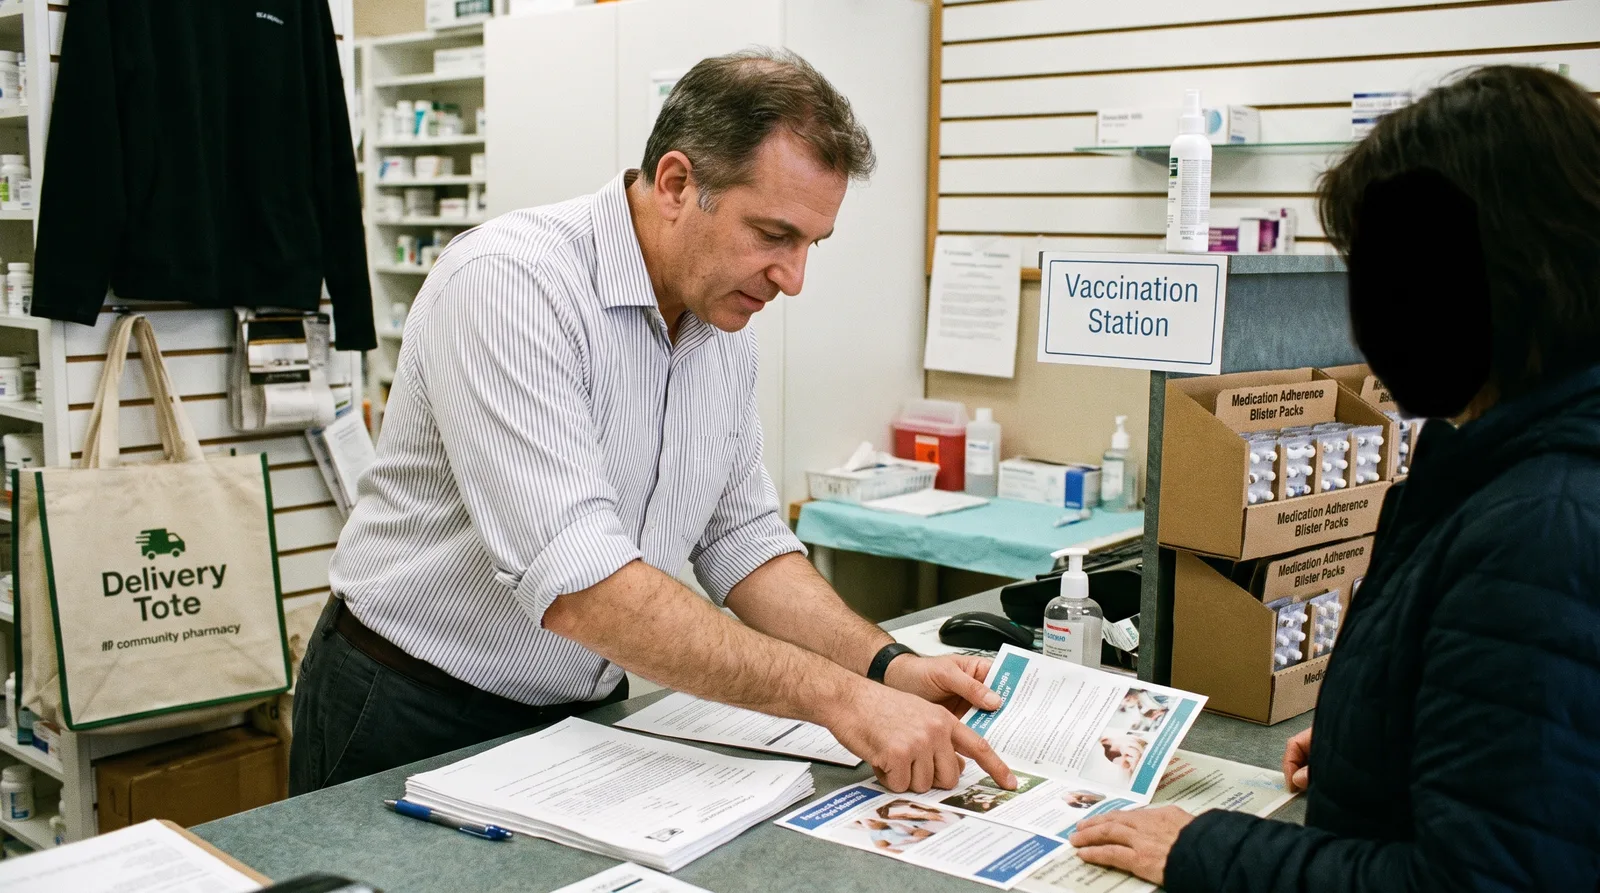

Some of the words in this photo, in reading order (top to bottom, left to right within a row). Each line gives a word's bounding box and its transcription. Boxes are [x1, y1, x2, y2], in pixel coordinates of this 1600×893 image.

[1065, 273, 1198, 303] Vaccination
[1088, 308, 1169, 337] Station
[1231, 392, 1278, 407] Medication
[1280, 388, 1324, 402] Adherence
[1249, 408, 1277, 421] Blister
[1279, 405, 1304, 418] Packs
[1277, 507, 1323, 525] Medication
[1326, 499, 1369, 515] Adherence
[1295, 522, 1322, 537] Blister
[1324, 516, 1349, 531] Packs
[1278, 557, 1322, 578] Medication
[1324, 546, 1365, 565] Adherence
[1322, 565, 1346, 580] Packs
[102, 564, 227, 597] Delivery
[133, 594, 201, 621] Tote
[116, 631, 179, 650] community
[182, 623, 241, 641] pharmacy
